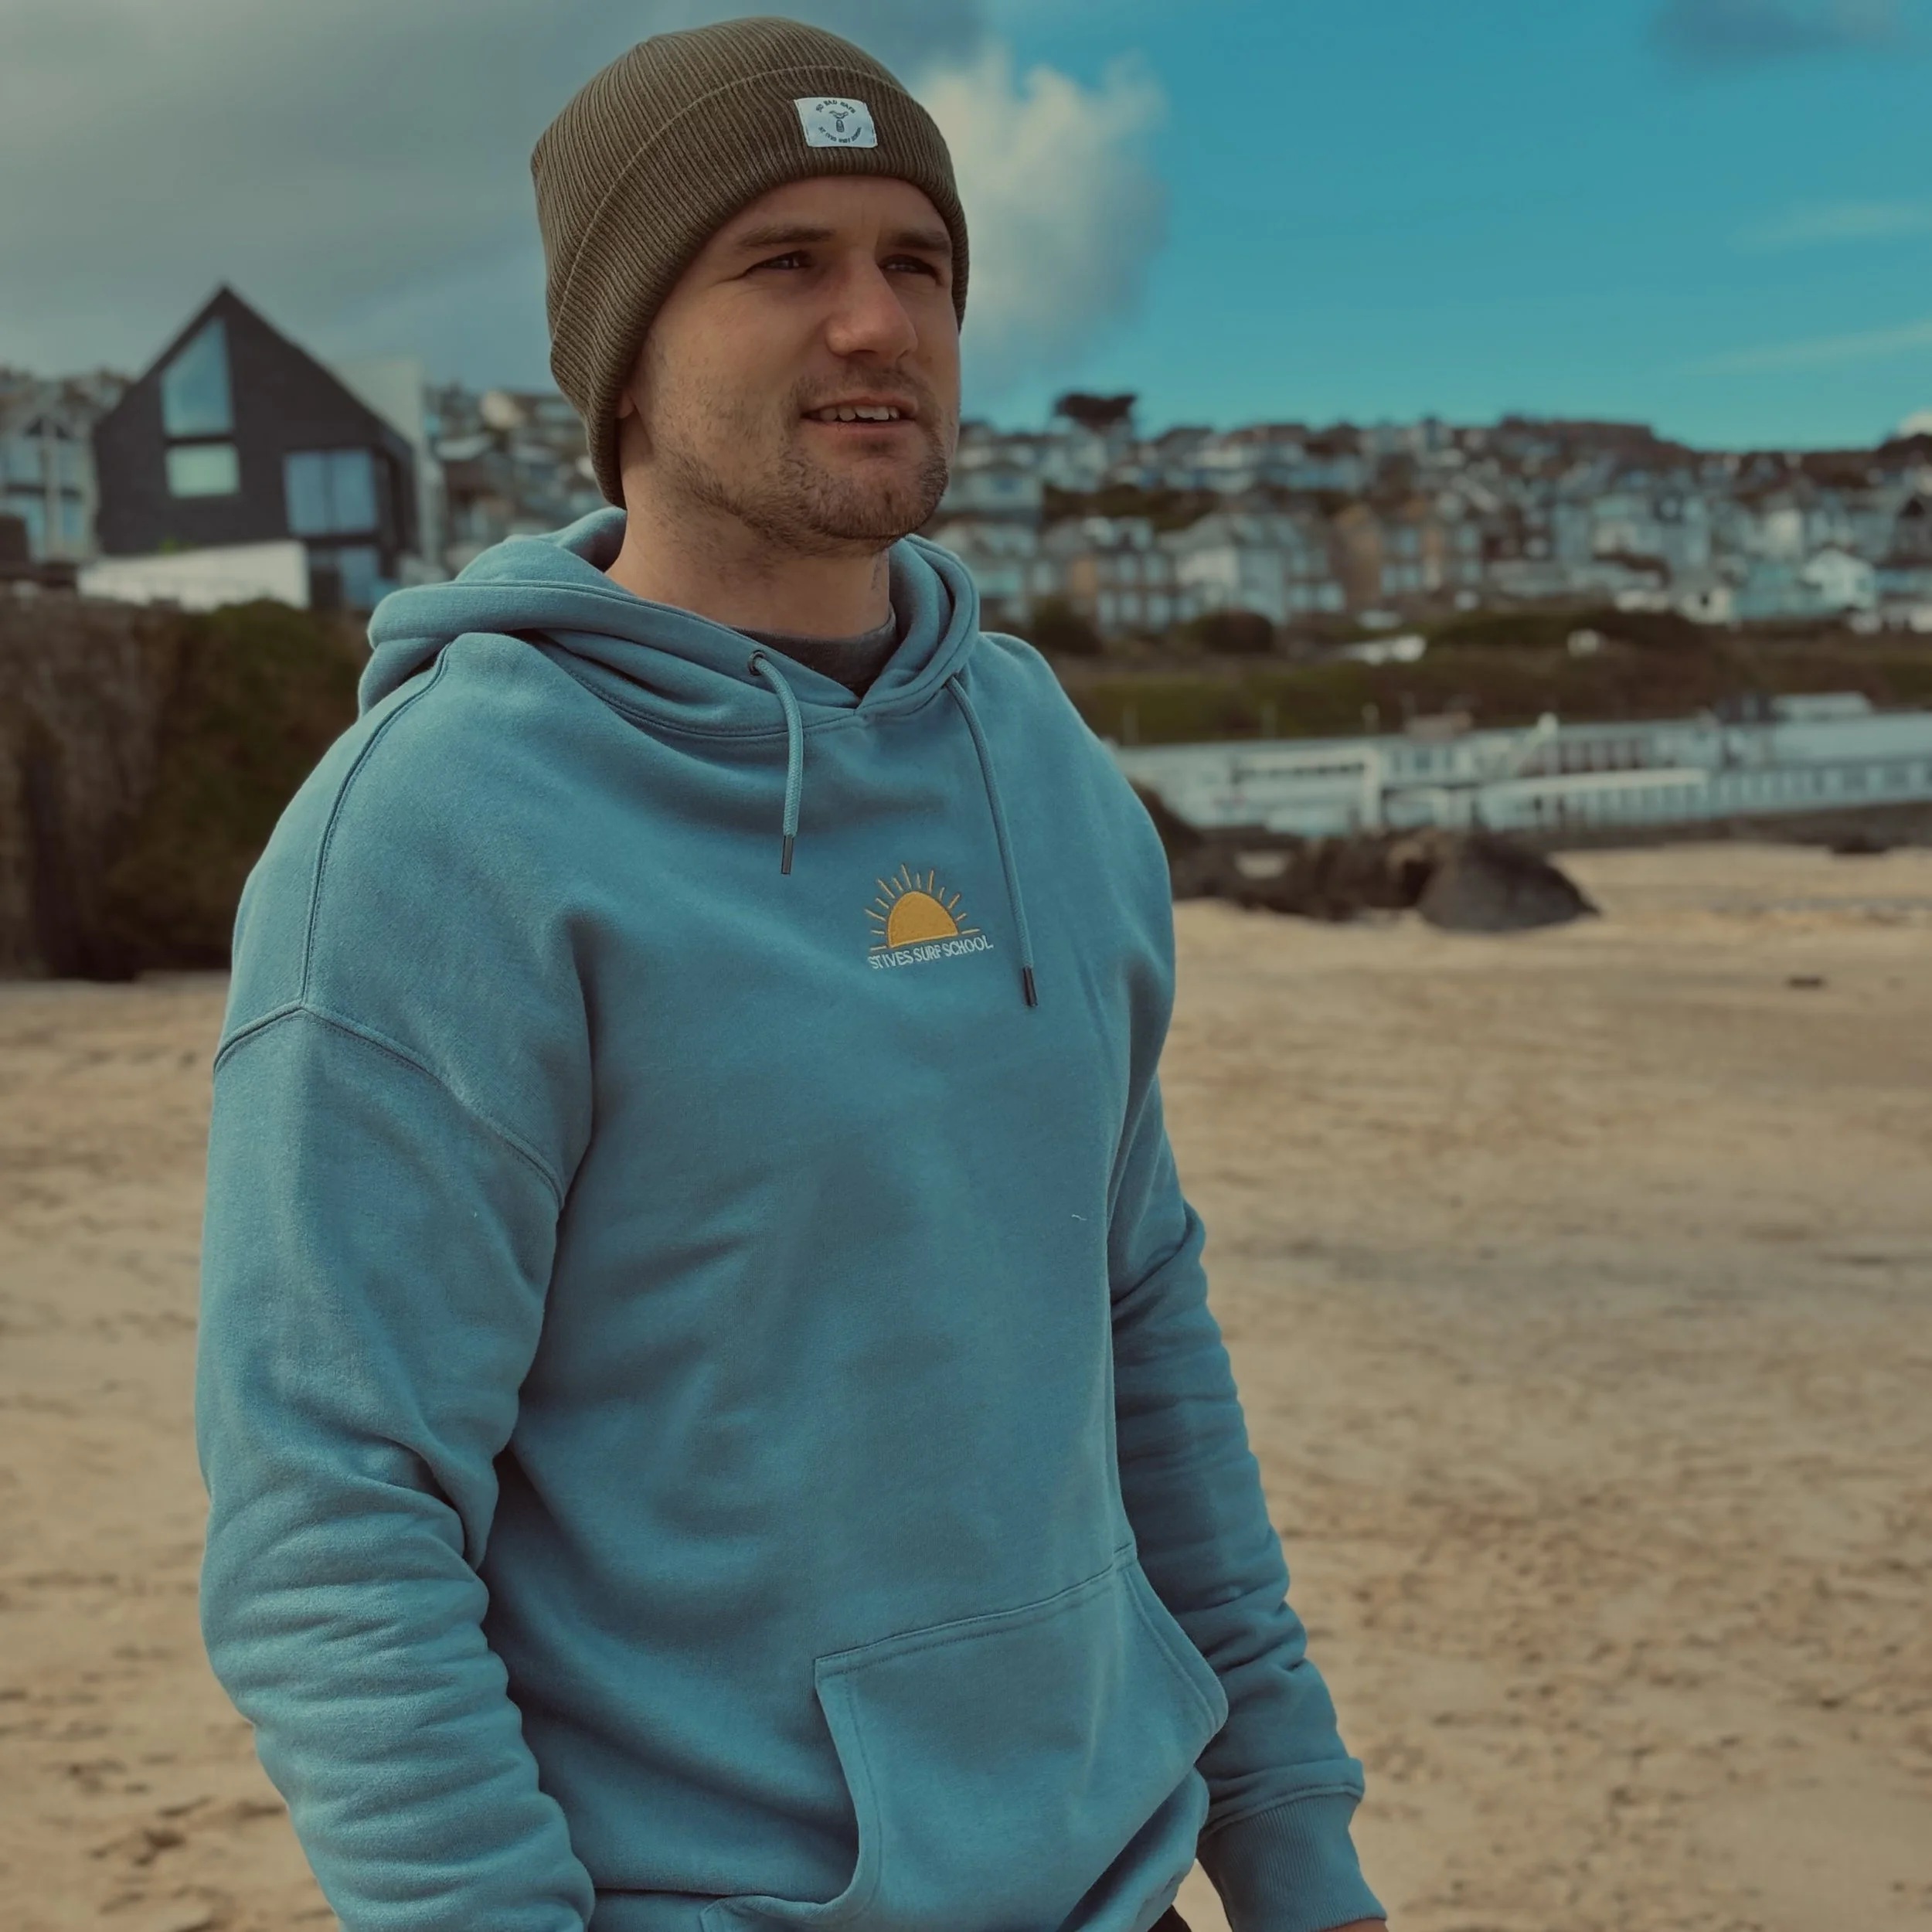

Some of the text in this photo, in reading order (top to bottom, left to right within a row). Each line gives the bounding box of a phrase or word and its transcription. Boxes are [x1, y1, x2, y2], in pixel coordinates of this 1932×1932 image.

[868, 934, 995, 970] ST IVES SURF SCHOOL
